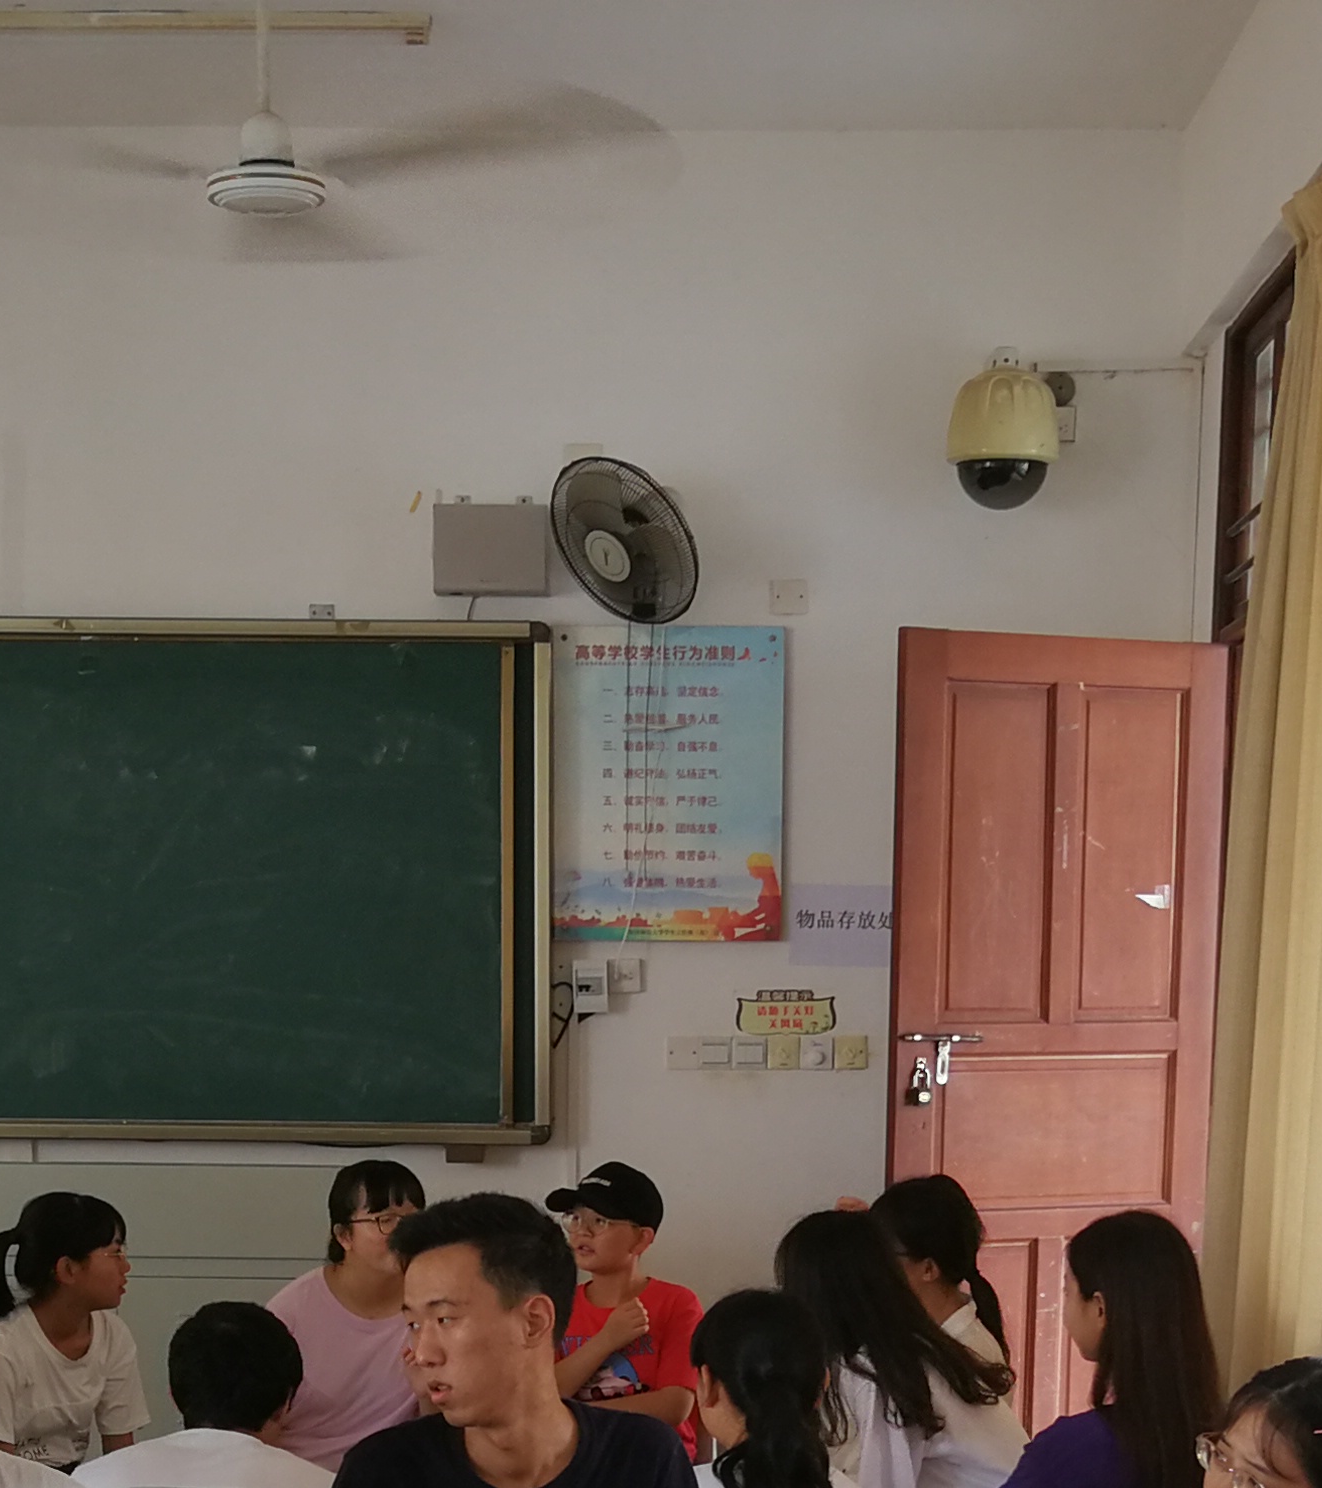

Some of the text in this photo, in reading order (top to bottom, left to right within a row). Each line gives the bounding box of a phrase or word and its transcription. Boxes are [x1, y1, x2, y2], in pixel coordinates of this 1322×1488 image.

[575, 644, 735, 661] 高等学校学生行为准则
[795, 909, 892, 930] 物品存放处
[18, 1443, 50, 1461] OME
